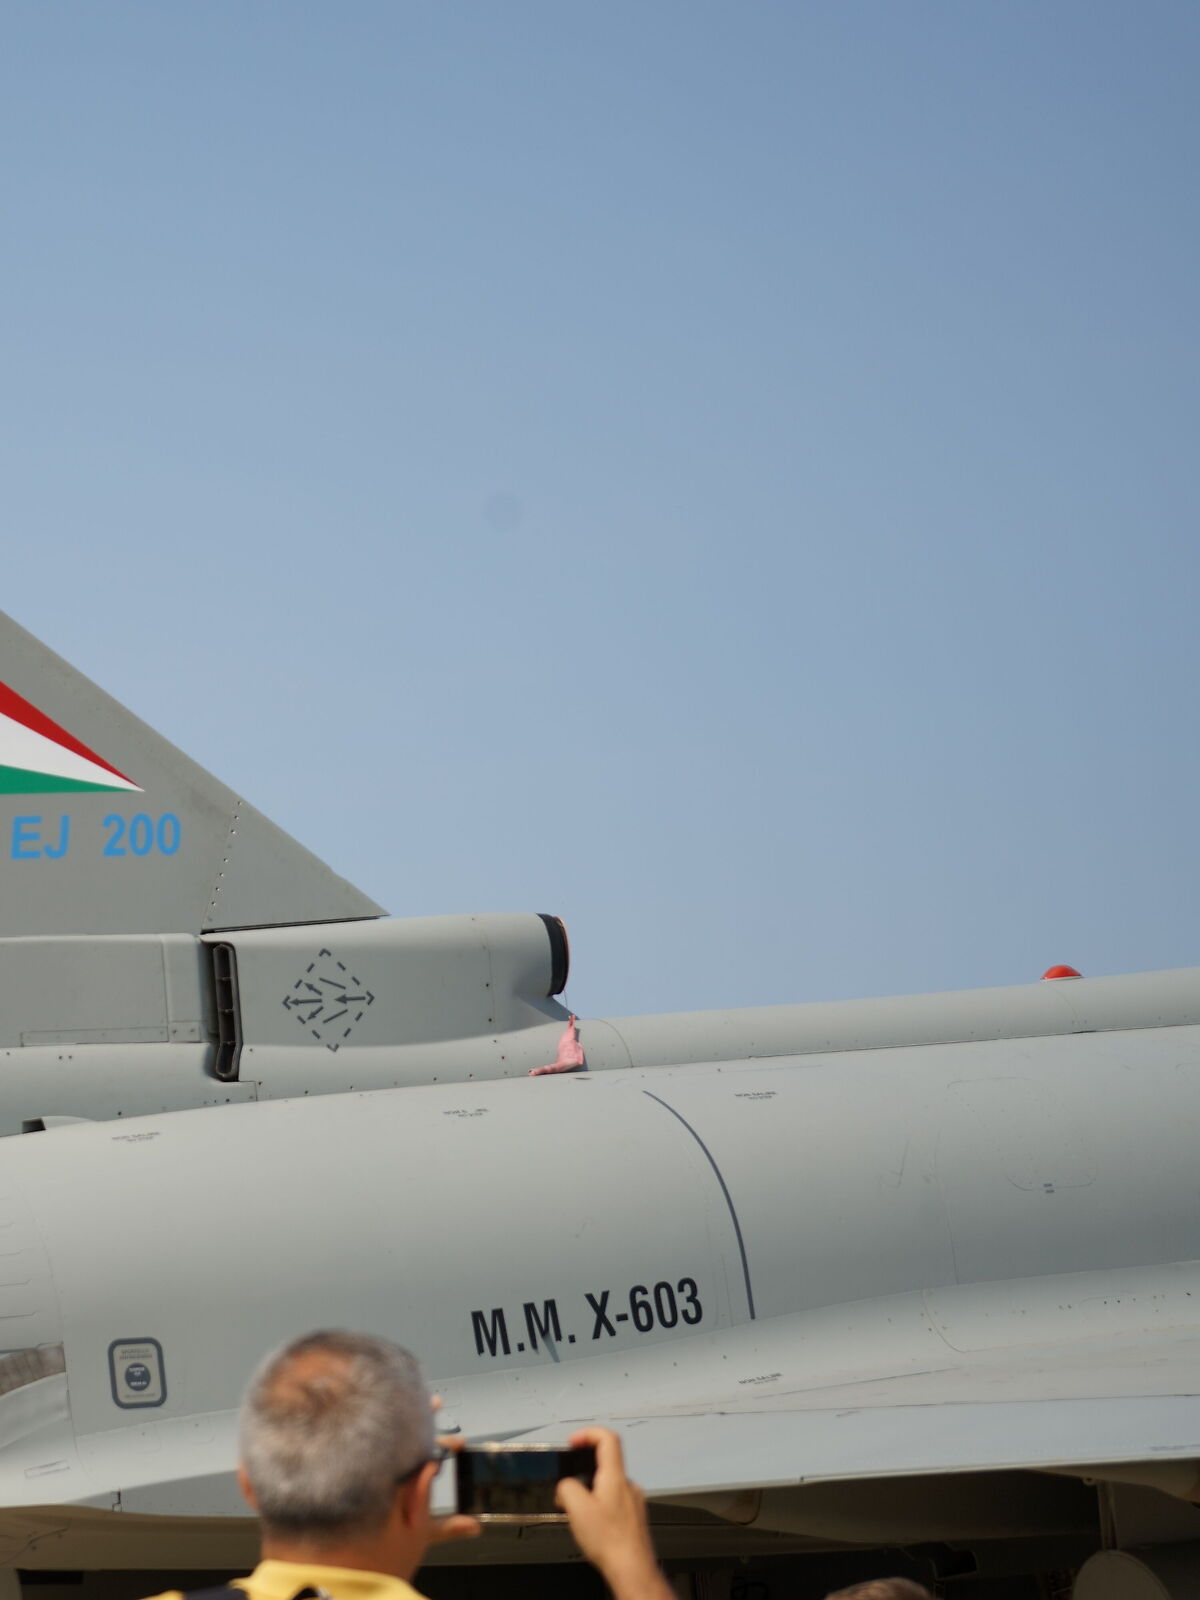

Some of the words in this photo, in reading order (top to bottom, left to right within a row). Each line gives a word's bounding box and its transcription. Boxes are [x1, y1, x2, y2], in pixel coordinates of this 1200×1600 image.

[9, 814, 71, 860] EJ
[102, 811, 182, 857] 200
[470, 1298, 577, 1358] M.M.
[584, 1276, 704, 1341] X-603
